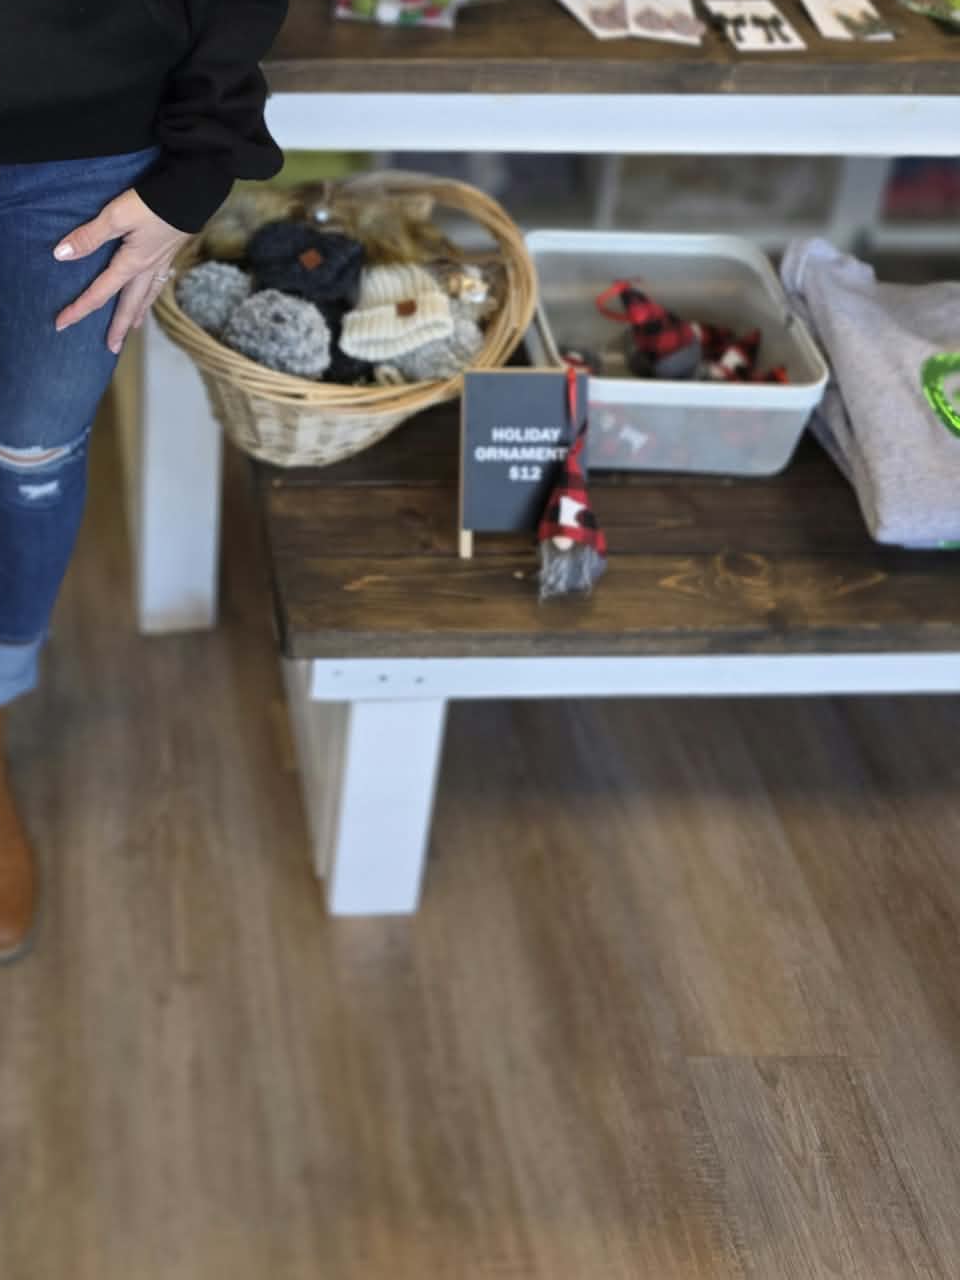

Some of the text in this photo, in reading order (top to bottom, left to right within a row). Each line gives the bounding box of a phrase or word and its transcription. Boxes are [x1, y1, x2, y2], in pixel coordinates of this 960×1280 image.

[492, 427, 561, 442] HOLIDAY
[474, 446, 568, 462] ORNAMENT
[509, 466, 542, 481] $12
